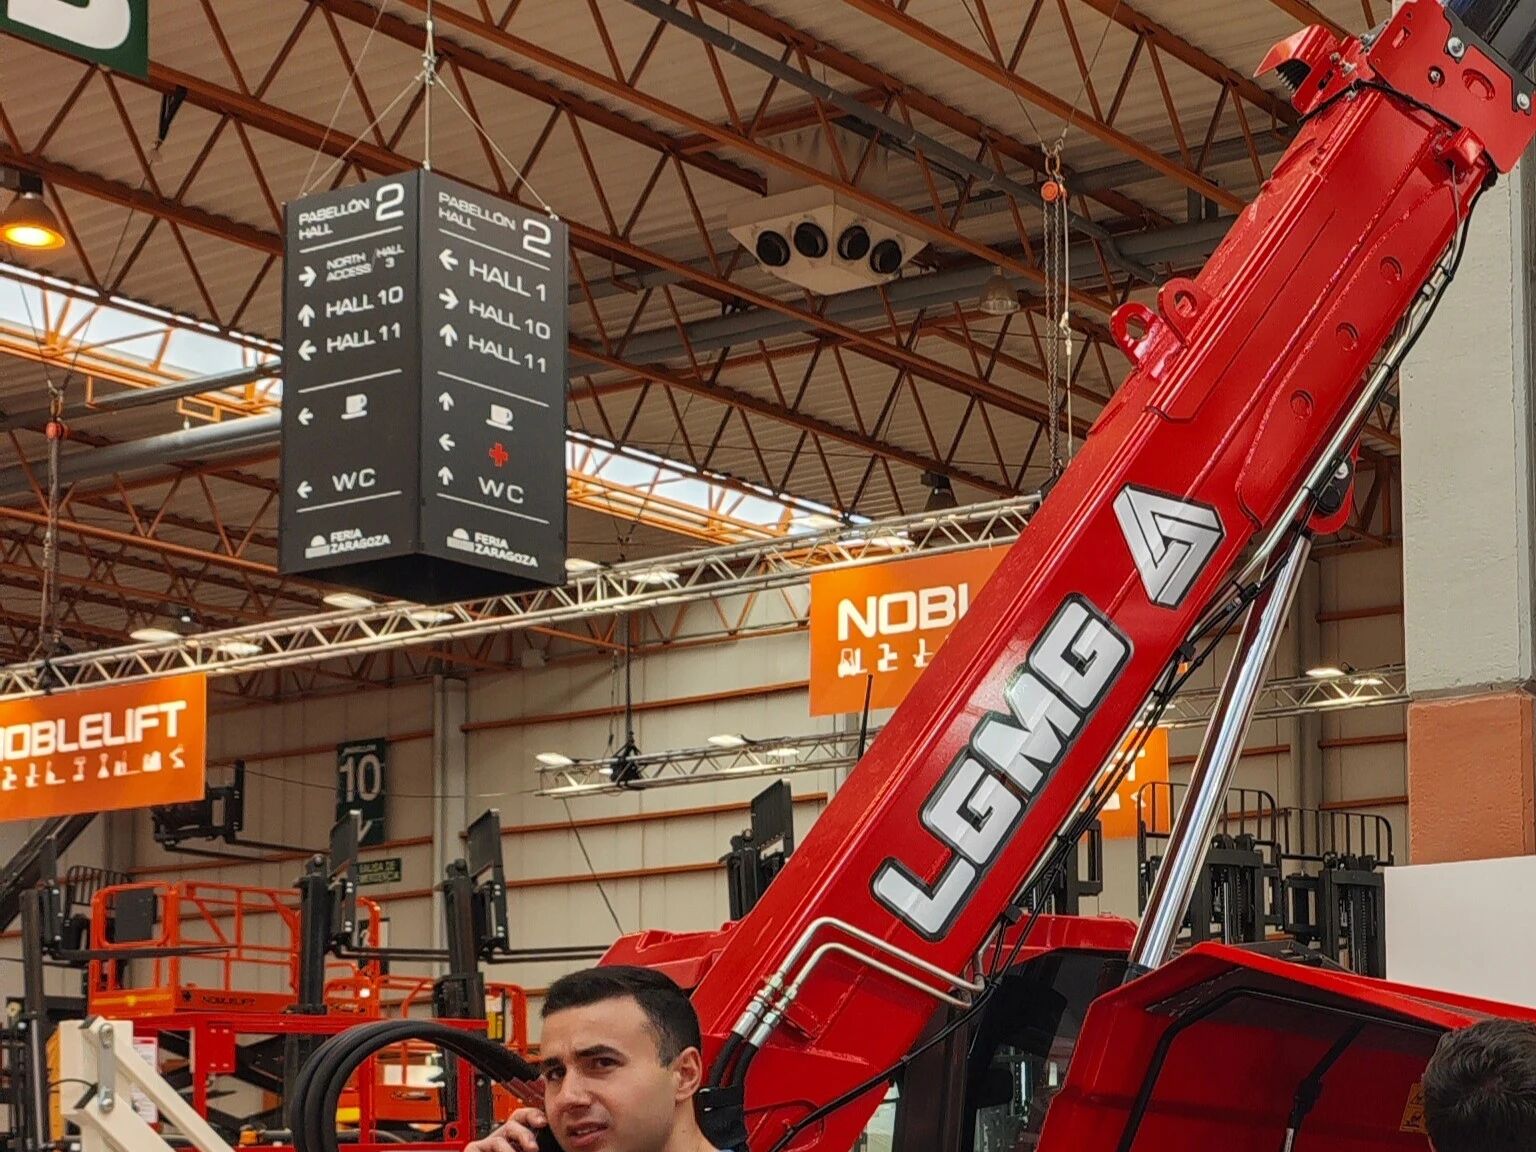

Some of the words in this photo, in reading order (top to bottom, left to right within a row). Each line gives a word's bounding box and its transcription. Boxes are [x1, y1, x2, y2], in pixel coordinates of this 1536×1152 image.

[376, 183, 404, 220] 2
[299, 223, 333, 240] HALL
[439, 207, 476, 231] HALL
[375, 244, 405, 258] HALL
[523, 218, 551, 258] 2
[326, 252, 366, 270] NORTH
[326, 263, 372, 281] ACCESS
[385, 257, 395, 268] 3
[469, 258, 531, 297] HALL
[535, 283, 546, 302] 1
[326, 294, 374, 318] HALL
[377, 286, 403, 305] 10
[469, 299, 521, 331] HALL
[525, 318, 550, 339] 10
[327, 329, 376, 353] HALL
[379, 322, 400, 341] 11
[469, 334, 521, 365] HALL
[524, 353, 546, 373] 11
[332, 467, 376, 492] WC
[478, 476, 524, 504] WC
[330, 528, 362, 543] FERIA
[330, 534, 391, 554] ZARAGOZA
[474, 531, 509, 549] FERIA
[473, 543, 539, 568] ZARAGOZA
[0, 700, 187, 762] OBLELIFT
[339, 754, 381, 803] 10
[870, 597, 1130, 938] LGMG
